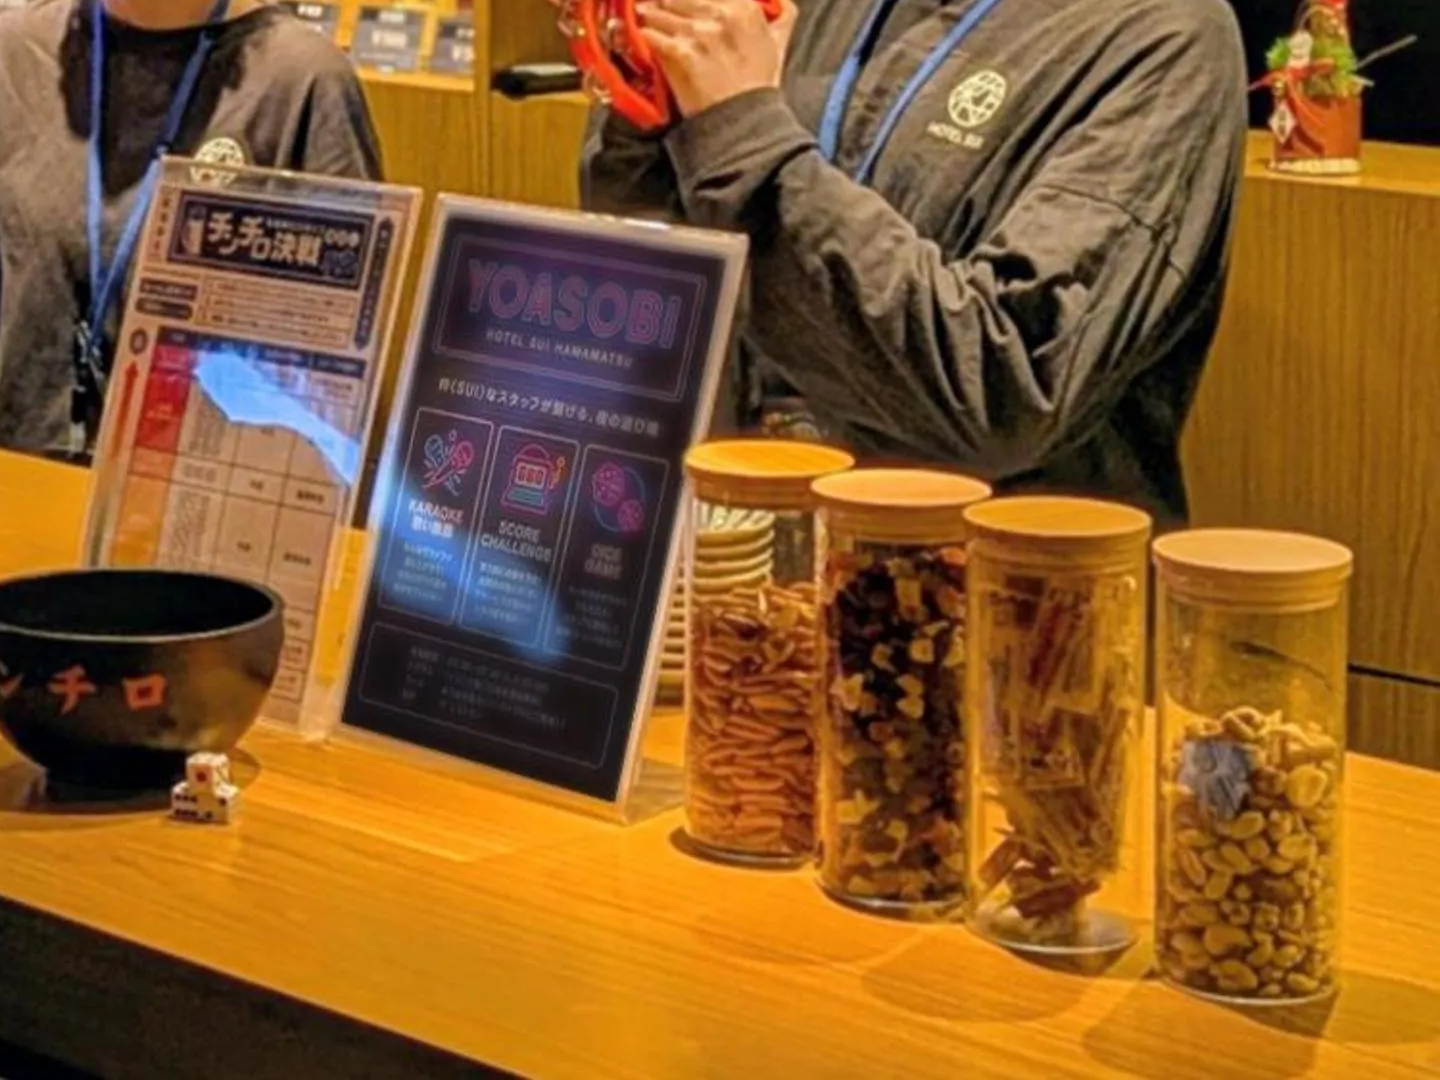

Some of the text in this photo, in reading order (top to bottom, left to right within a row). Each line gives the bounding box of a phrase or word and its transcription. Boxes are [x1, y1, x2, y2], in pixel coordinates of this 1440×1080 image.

[468, 258, 682, 350] YOASOBI
[485, 327, 524, 347] HOTEL
[554, 343, 634, 368] HAMAMATSU
[408, 499, 464, 523] KARAOKE
[499, 519, 541, 543] SCORE
[481, 533, 552, 563] CHALLENGE
